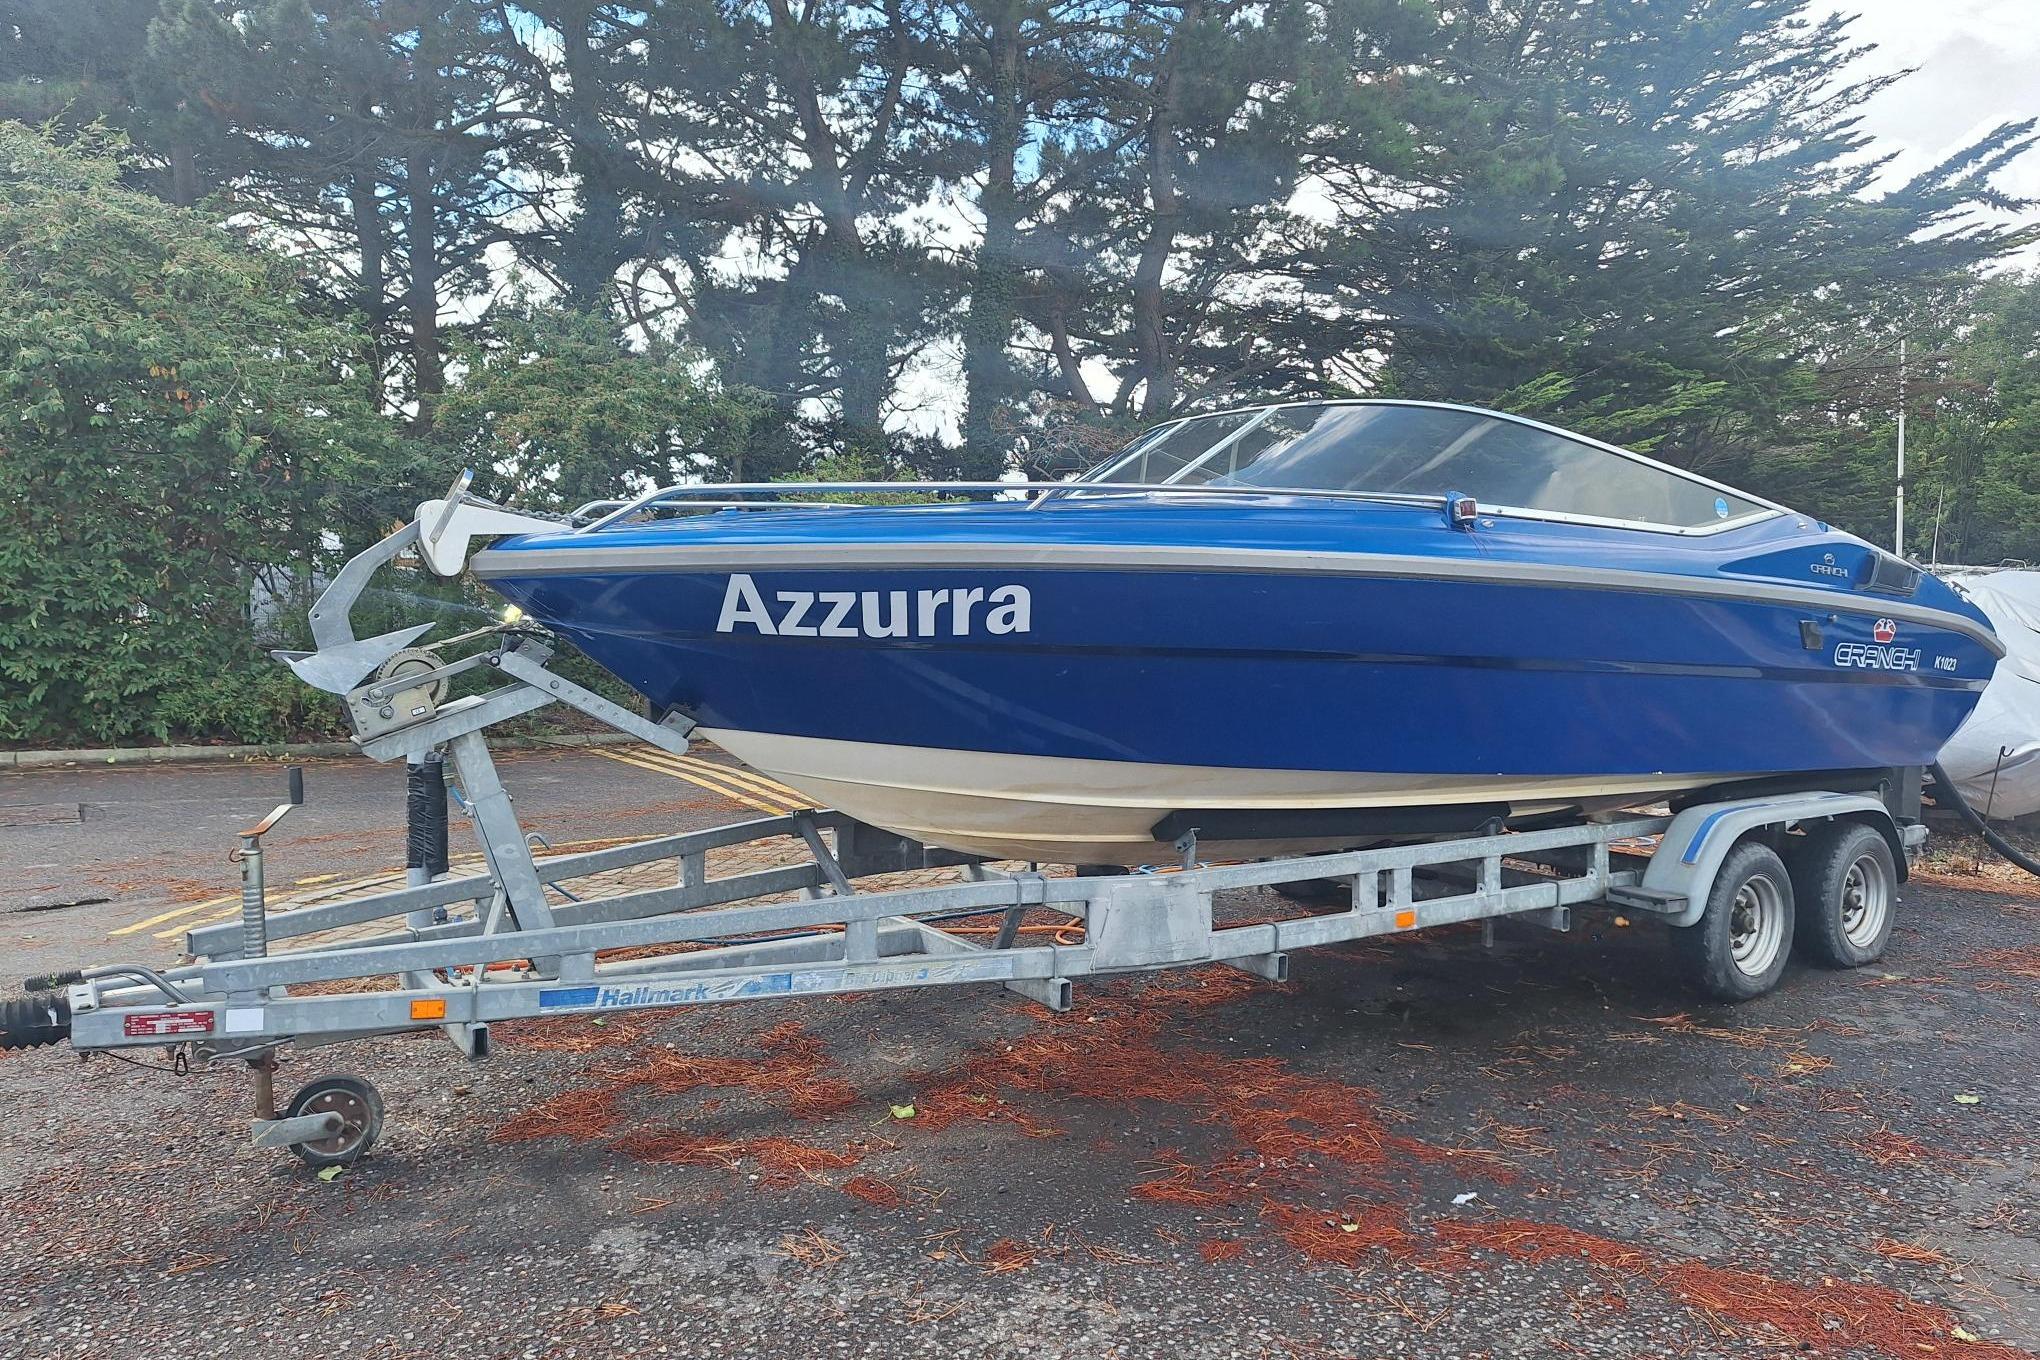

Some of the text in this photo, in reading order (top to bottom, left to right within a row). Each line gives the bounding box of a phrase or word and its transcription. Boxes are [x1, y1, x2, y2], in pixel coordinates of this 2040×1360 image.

[716, 573, 1031, 638] Azzurra
[1834, 642, 1921, 671] CRANCHI
[1934, 655, 1957, 672] K1023
[600, 983, 708, 1007] Hallmark
